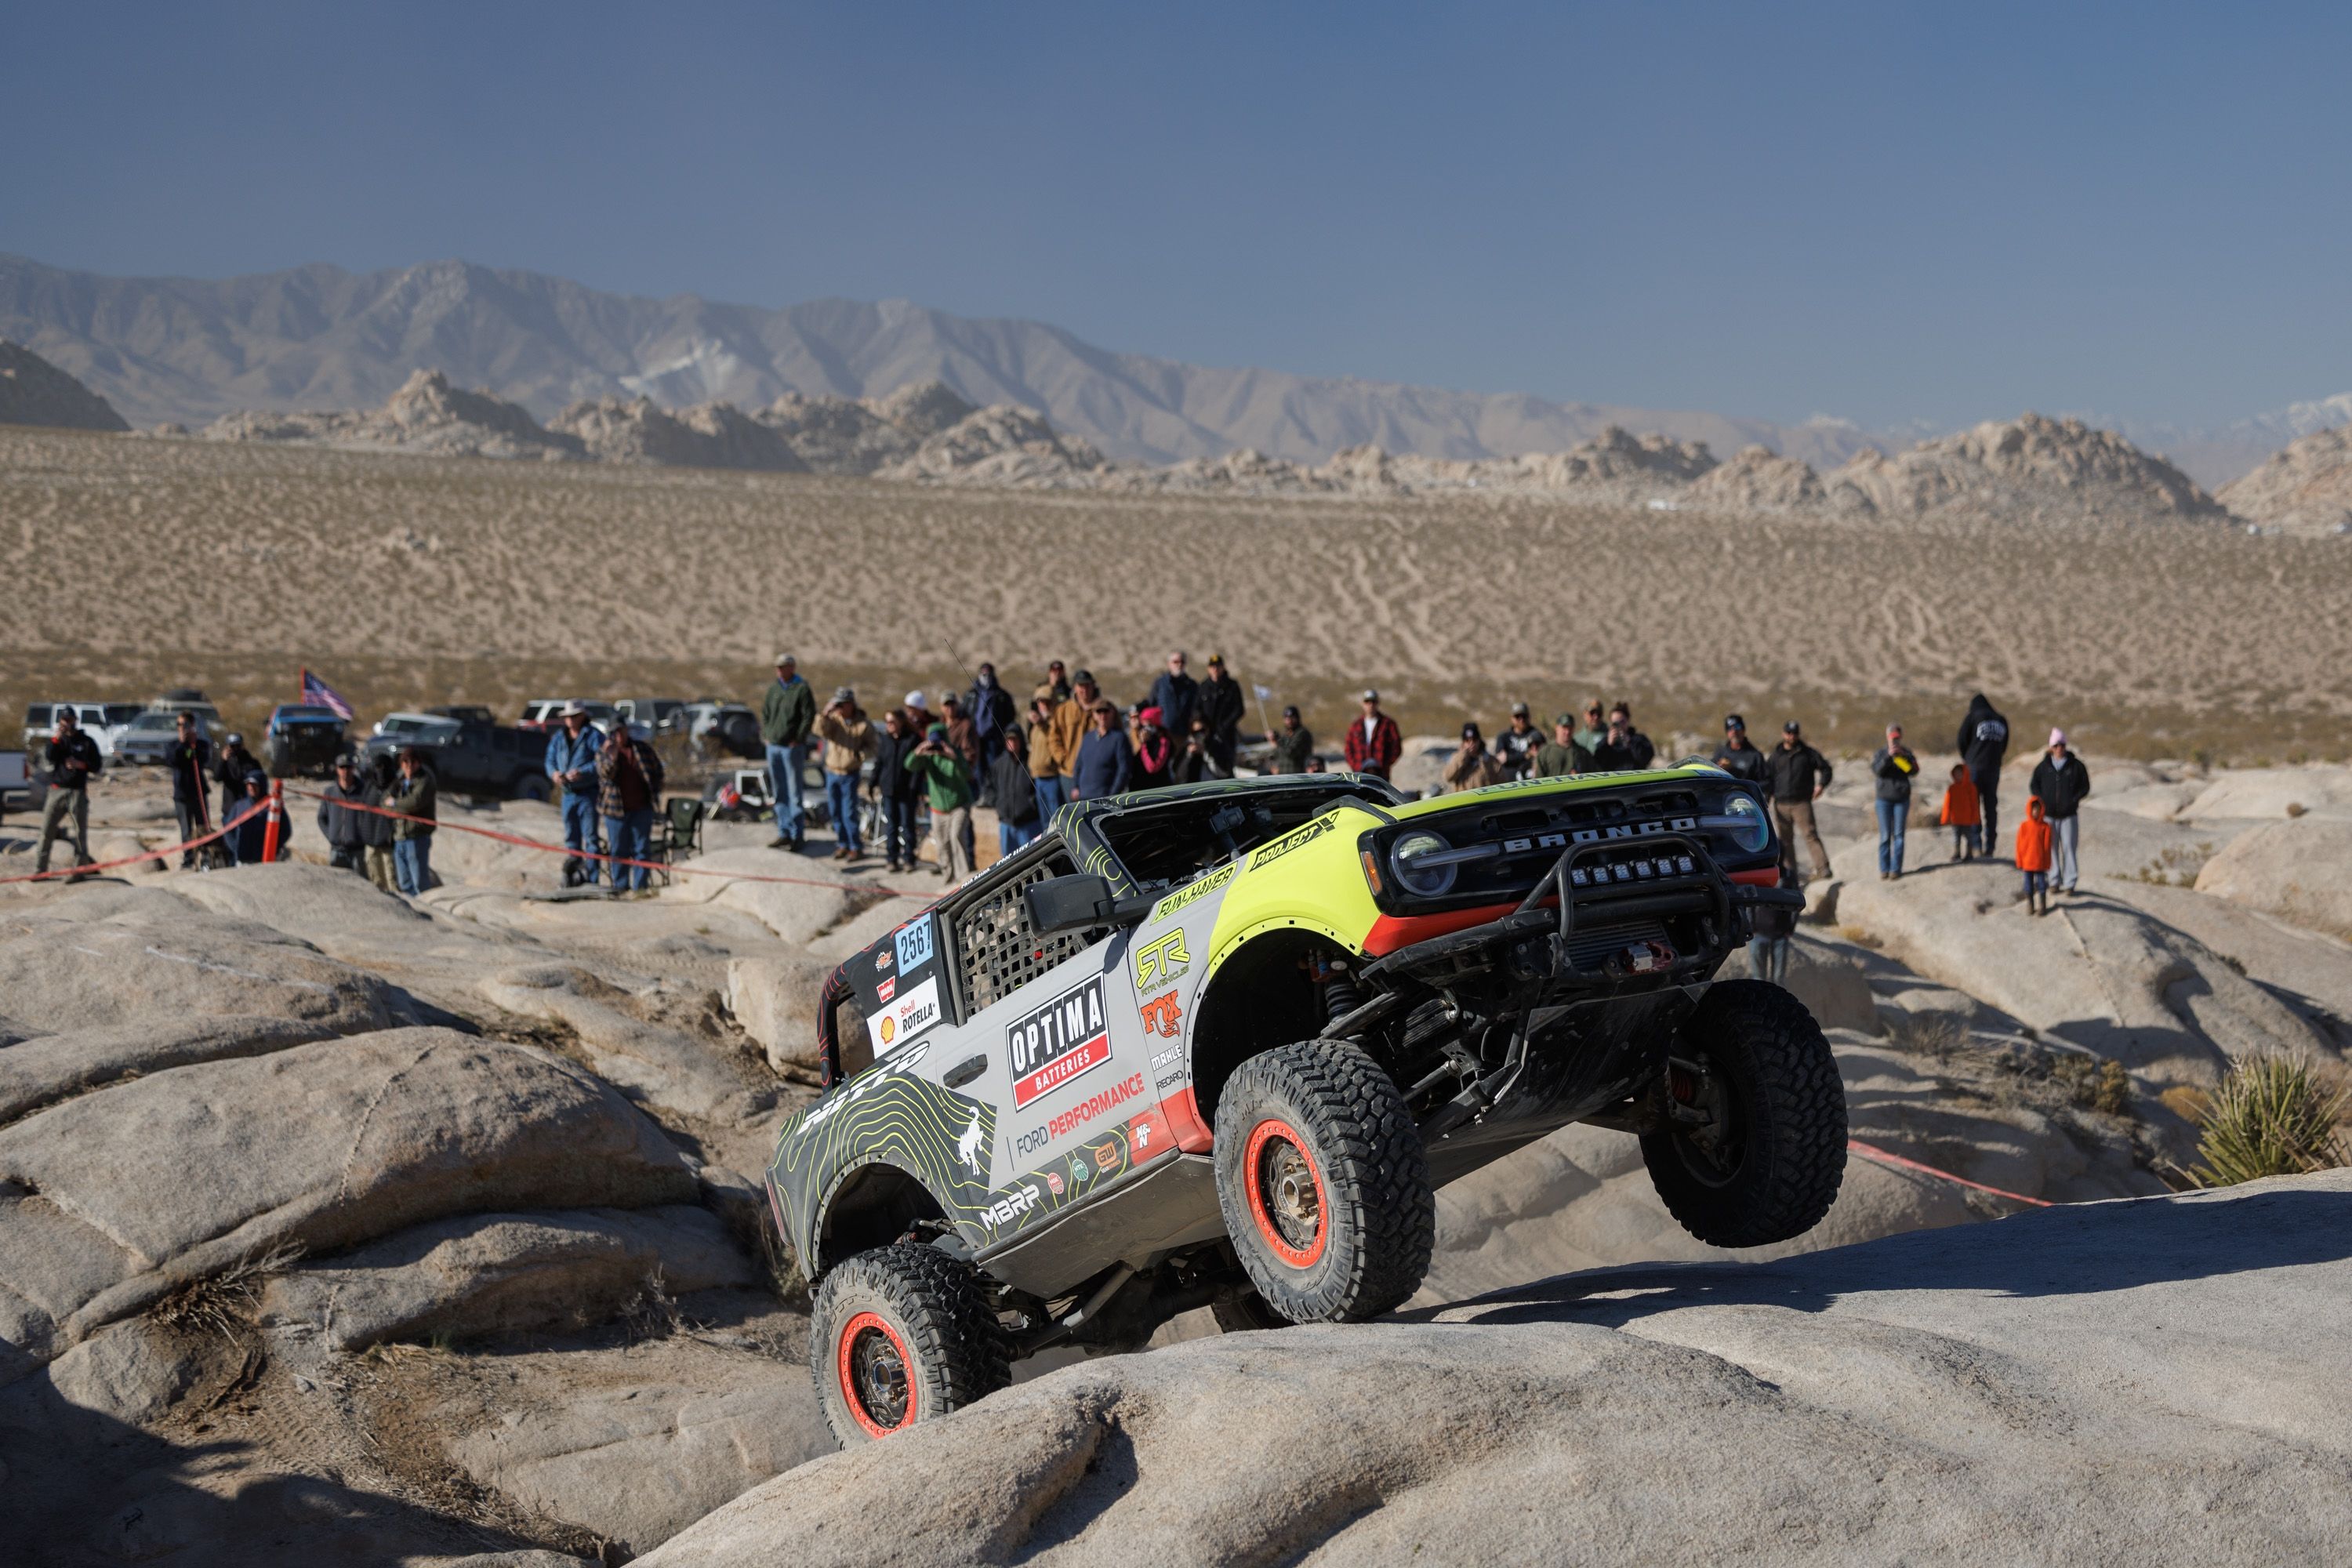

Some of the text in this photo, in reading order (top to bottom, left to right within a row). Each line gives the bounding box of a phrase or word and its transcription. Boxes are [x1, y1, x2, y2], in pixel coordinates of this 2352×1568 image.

[1252, 825, 1319, 869] PROJECT
[1504, 817, 1696, 853] BRONCO
[1155, 866, 1234, 921] FUN-HAVER
[901, 920, 931, 966] 2567
[1156, 964, 1189, 988] VEHICLES
[901, 999, 916, 1018] Shell
[902, 1003, 934, 1033] ROTELLA
[1011, 987, 1103, 1073] OPTIMA
[1140, 989, 1183, 1038] FOX
[1035, 1048, 1091, 1091] BATTERIES
[1151, 1044, 1182, 1070] MAHLE
[1156, 1069, 1185, 1091] RECARO
[1017, 1073, 1145, 1159] FORD PERFORMANCE
[980, 1184, 1040, 1231] MBRP
